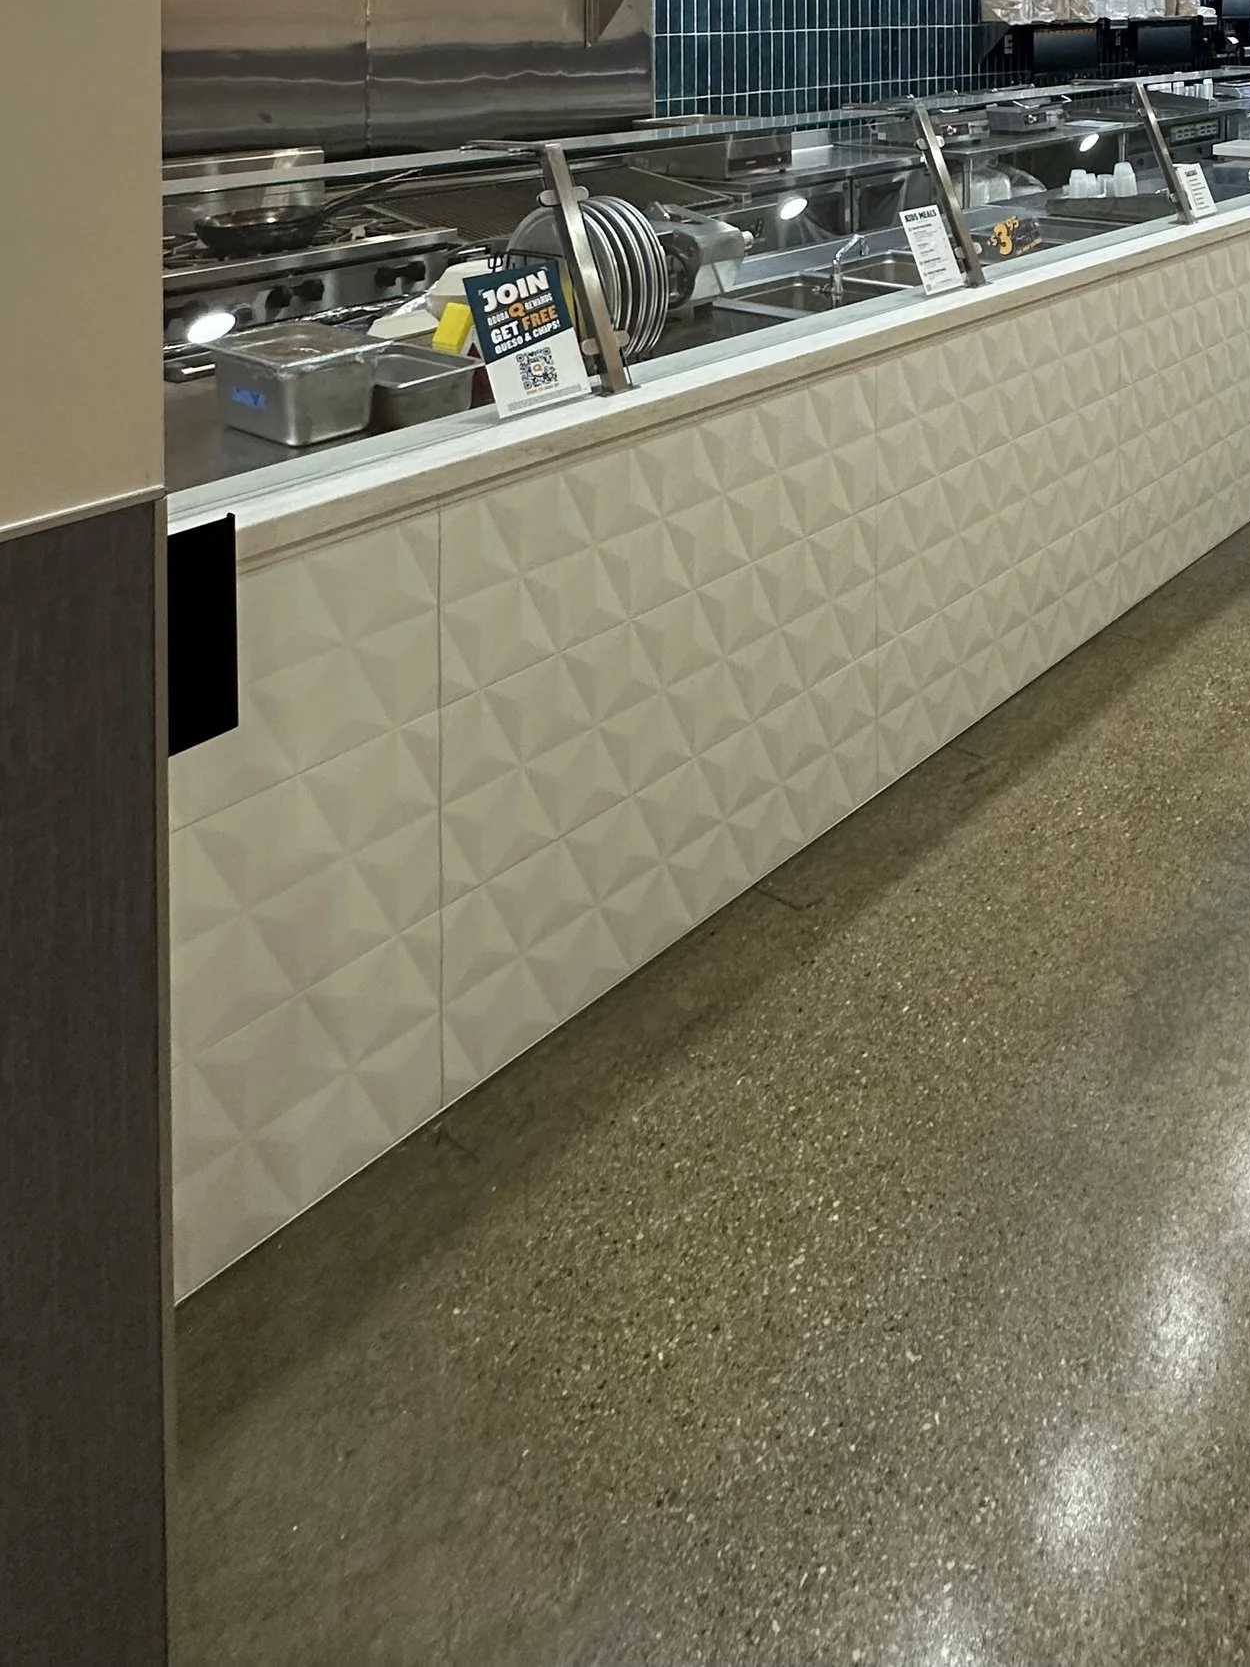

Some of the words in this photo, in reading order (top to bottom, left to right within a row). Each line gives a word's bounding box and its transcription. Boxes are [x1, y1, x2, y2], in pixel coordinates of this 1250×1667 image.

[919, 209, 937, 220] MEALS
[482, 270, 550, 312] JOIN
[491, 320, 519, 344] GET
[521, 304, 558, 331] FREE
[495, 335, 524, 354] QUESO
[524, 332, 532, 341] &
[532, 319, 561, 338] CHIPS!
